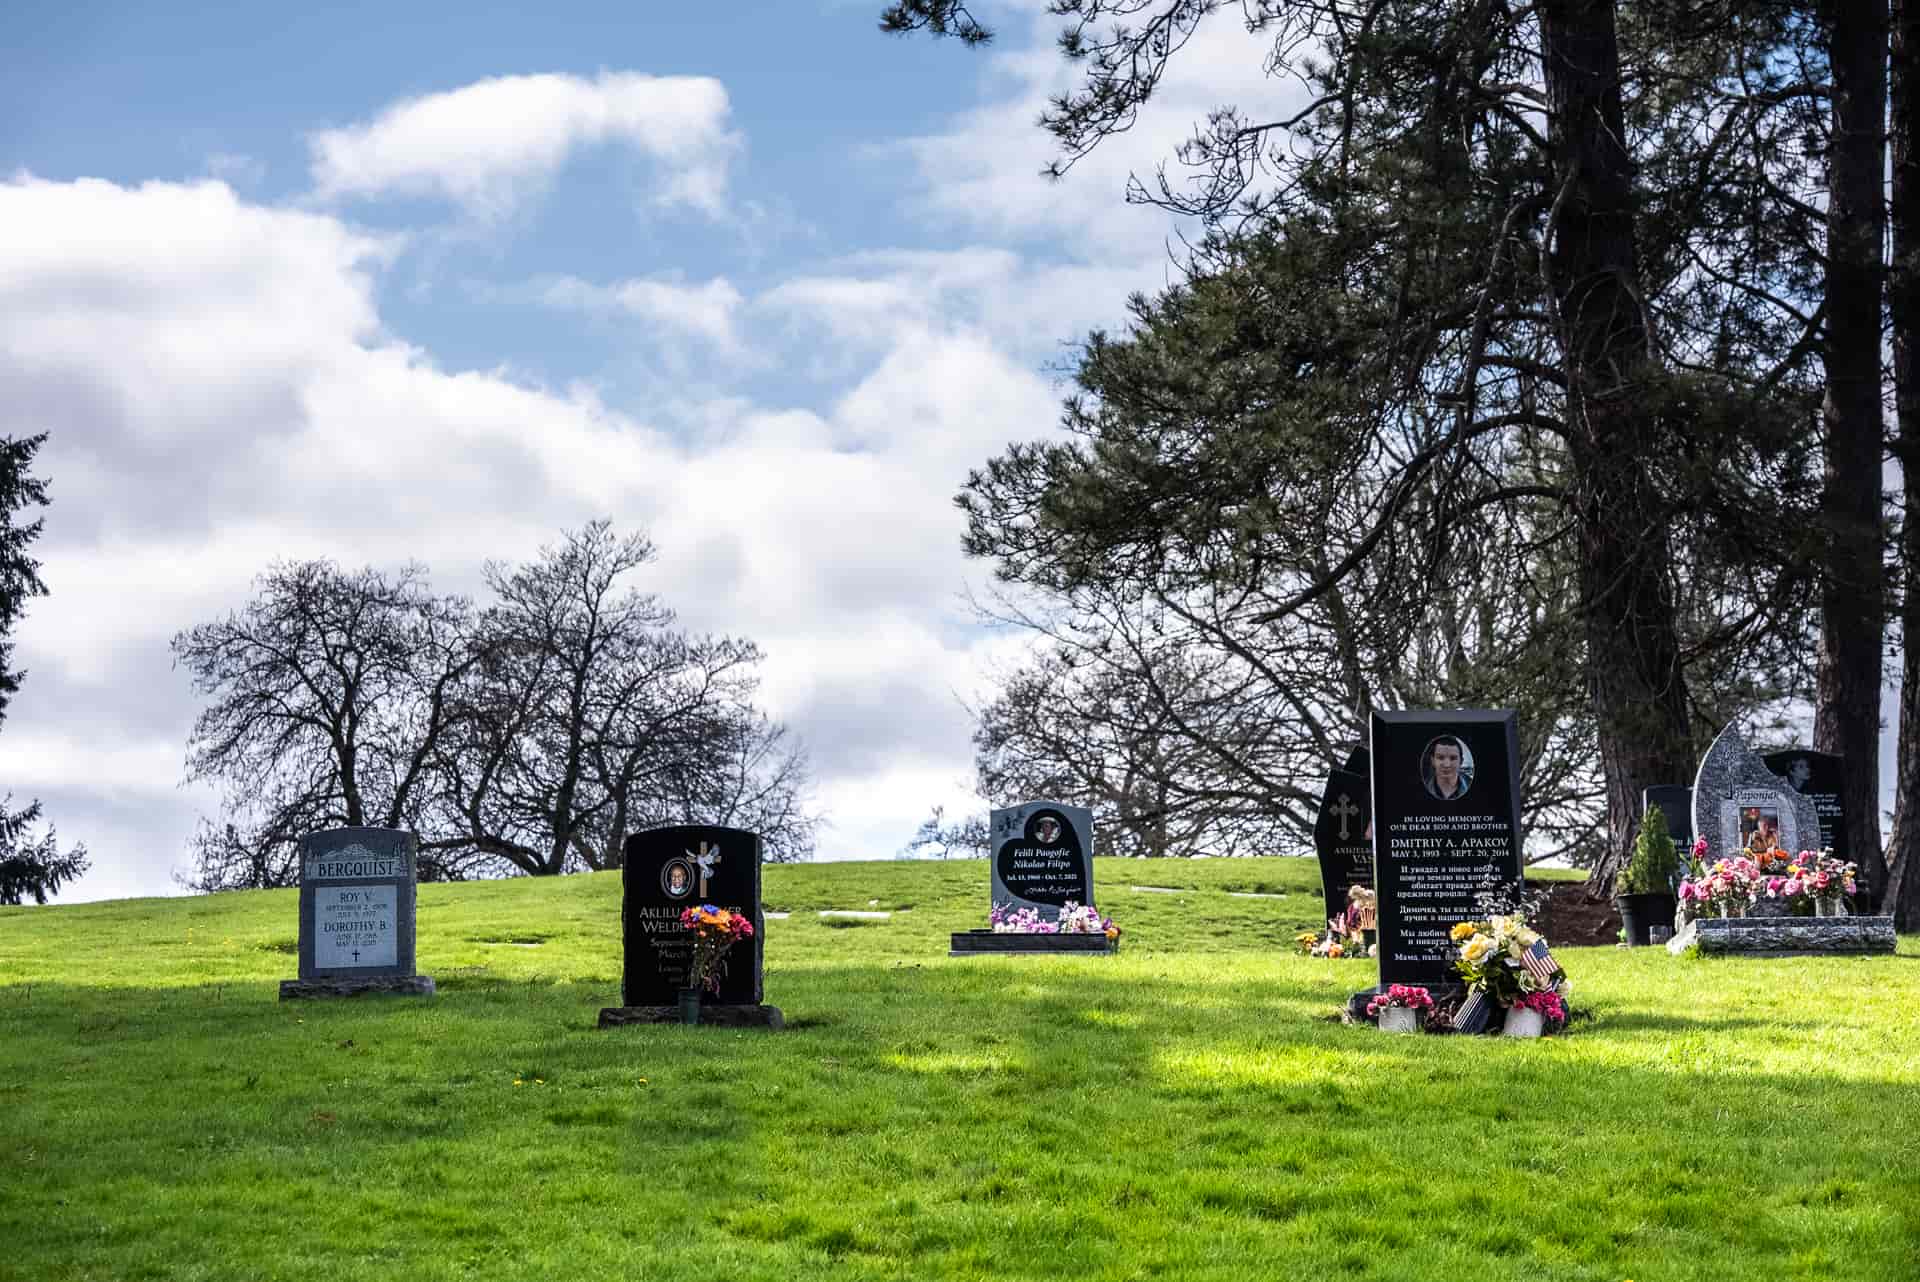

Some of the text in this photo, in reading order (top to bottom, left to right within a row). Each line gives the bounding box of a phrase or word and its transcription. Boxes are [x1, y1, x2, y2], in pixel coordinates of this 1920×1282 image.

[1403, 815, 1495, 823] IN LOVING MEMORY OF
[1390, 824, 1408, 832] OUR
[1408, 824, 1431, 832] DEAR
[1450, 823, 1470, 831] AND
[1471, 823, 1509, 831] BROTHER
[1390, 837, 1510, 849] DMITRIY A. APAKOV
[1391, 850, 1410, 858] MAY
[1450, 849, 1474, 857] SEPT.
[1477, 849, 1490, 857] 20,
[1492, 849, 1510, 857] 2014
[318, 861, 395, 877] BERGQUIST
[339, 892, 361, 903] ROY
[639, 905, 681, 919] AKLILU
[323, 920, 375, 932] DOROTHY
[641, 920, 689, 934] WELDE
